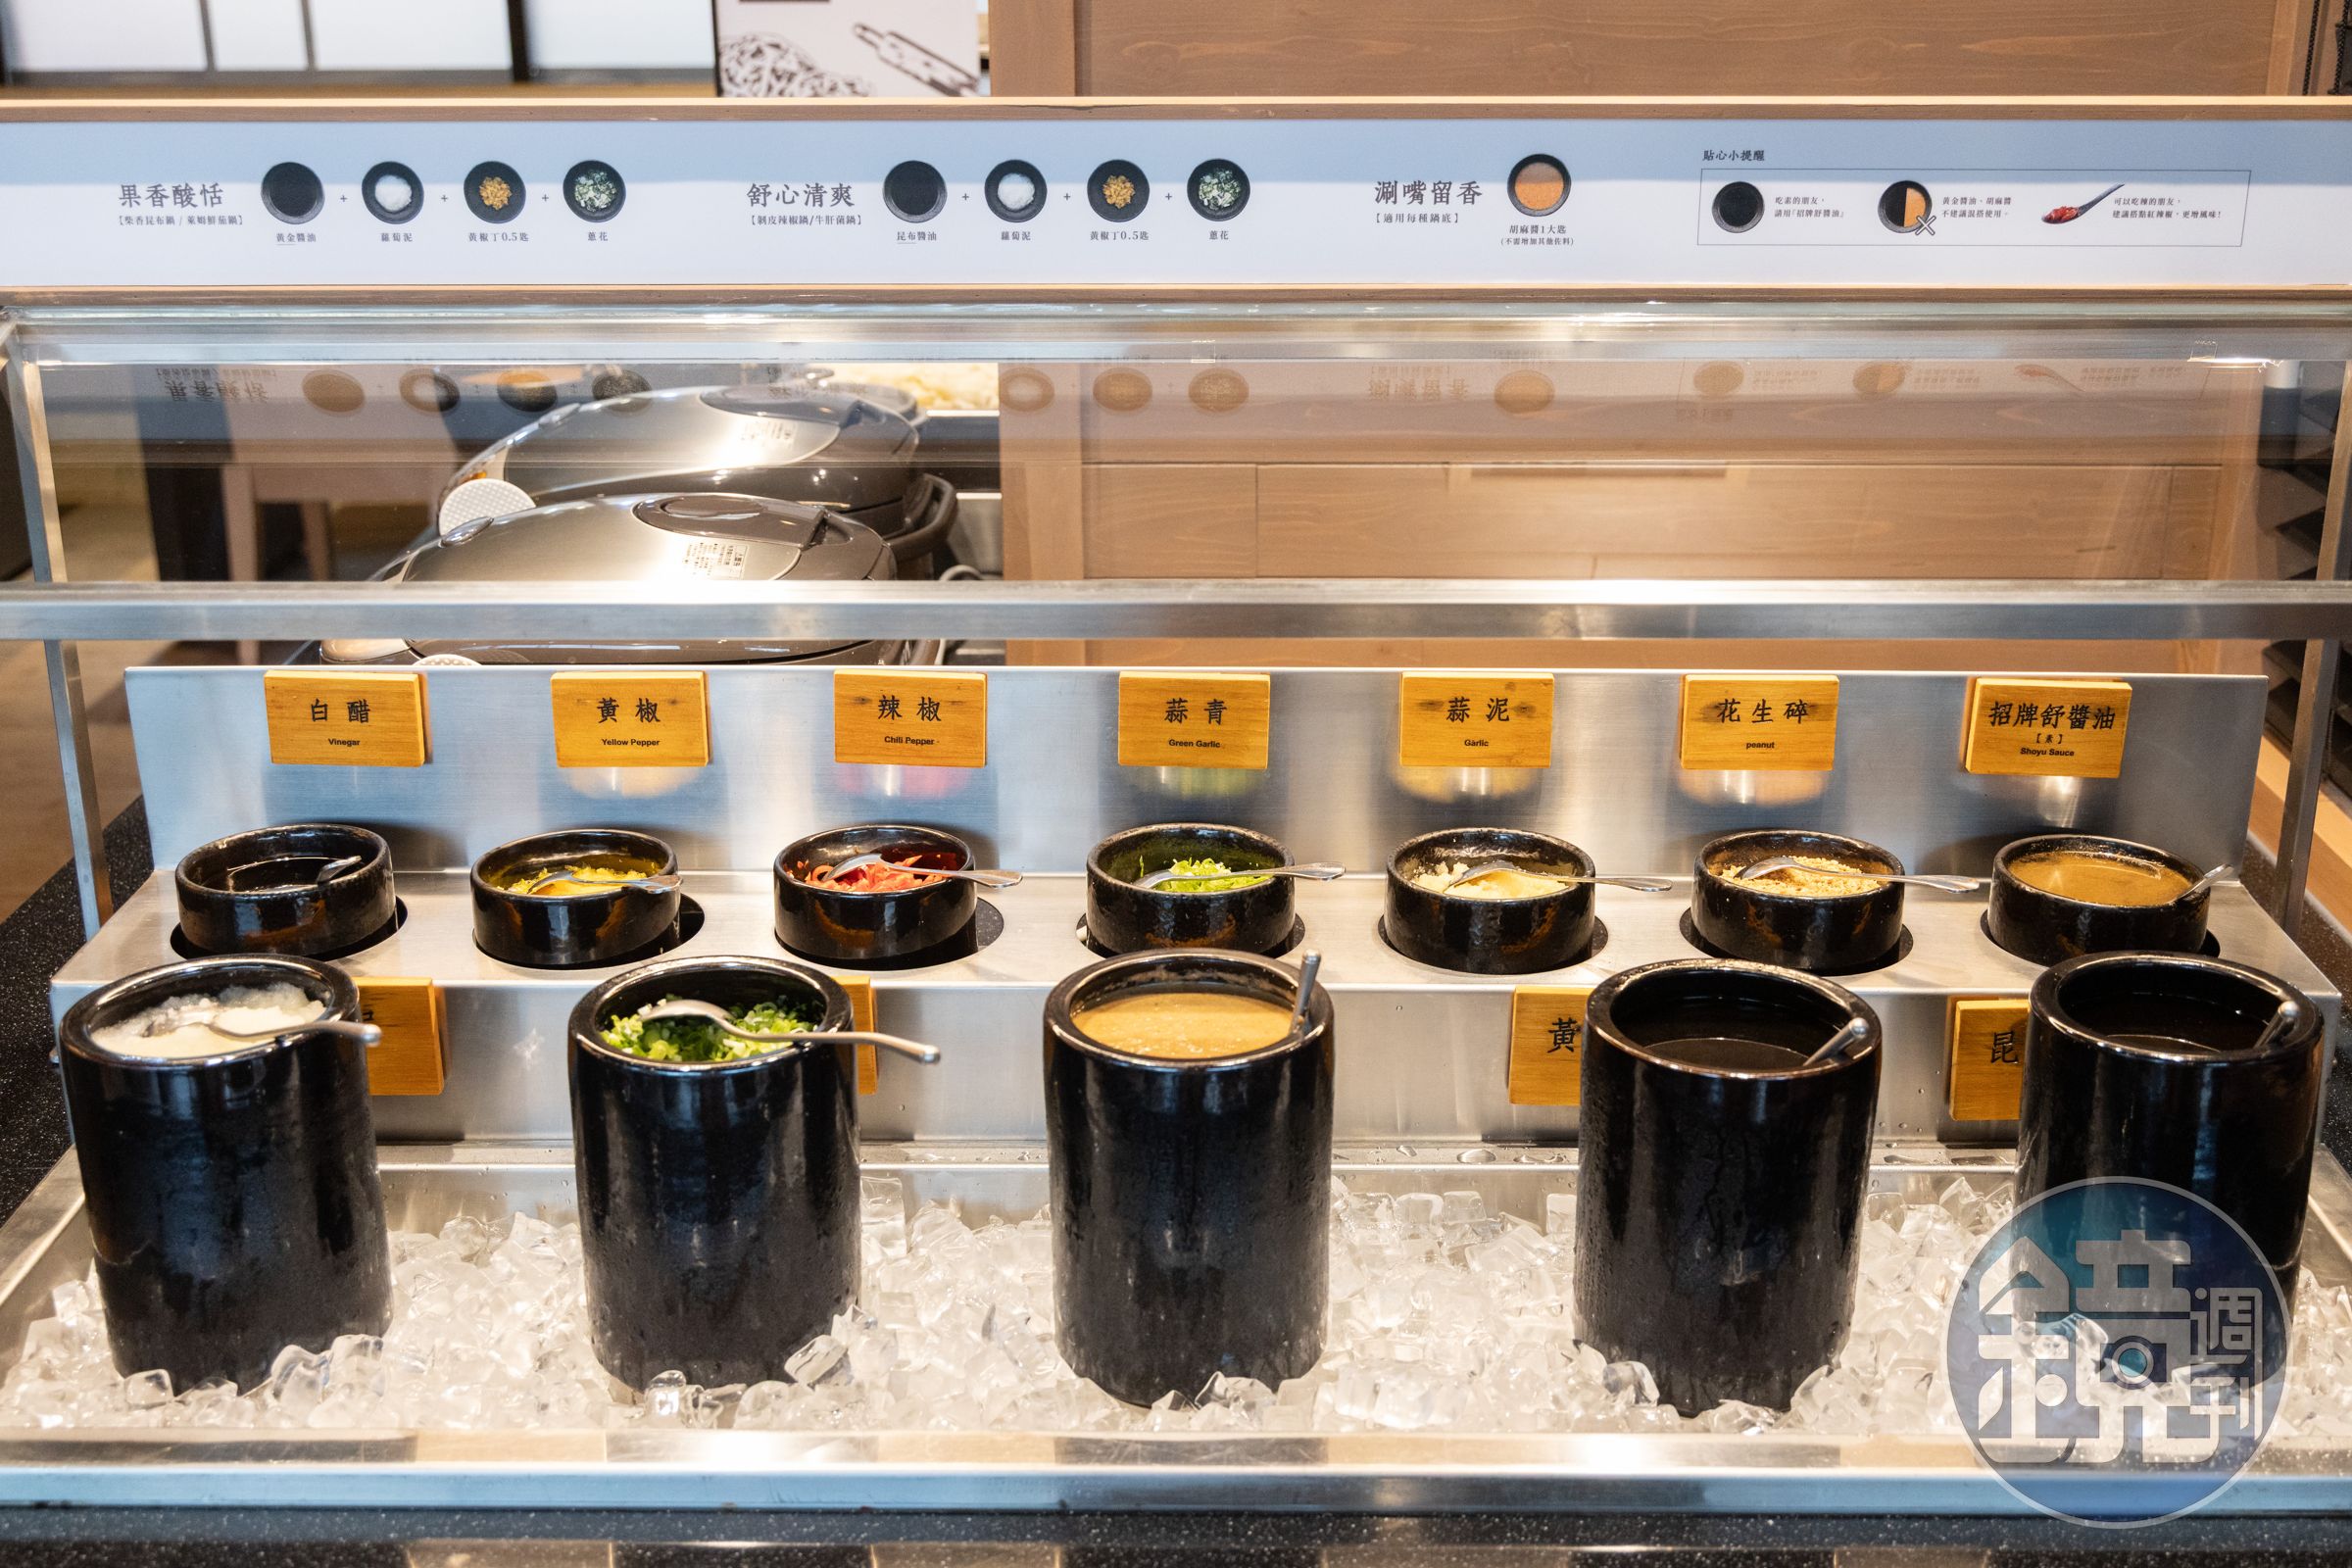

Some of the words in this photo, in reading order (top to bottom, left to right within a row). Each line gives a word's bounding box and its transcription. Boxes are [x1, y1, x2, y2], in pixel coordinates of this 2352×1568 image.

[1702, 149, 1765, 162] 貼心小提醒
[119, 182, 223, 208] 果香酸恬
[747, 182, 856, 208] 舒心清爽
[1374, 180, 1483, 205] 涮嘴留香
[1090, 230, 1150, 241] 黃椒丁0.5匙
[1208, 230, 1230, 240] 蔥花
[1509, 224, 1567, 234] 胡麻醬1大匙
[276, 232, 317, 243] 黃金醬油
[468, 231, 529, 243] 黃椒丁0.5匙
[587, 231, 609, 242] 蔥花
[897, 231, 937, 241] 昆布醬油
[310, 697, 371, 723] 白醋
[596, 697, 662, 724] 黃椒
[877, 694, 942, 722] 辣椒
[1164, 697, 1228, 726] 蒜青
[1446, 697, 1510, 723] 蒜泥
[1716, 698, 1809, 724] 花生碎
[1987, 701, 2116, 730] 招牌舒醬油
[328, 738, 361, 748] Vinegar
[601, 738, 628, 747] Yellow
[630, 738, 661, 749] Pepper
[884, 735, 904, 745] Chili
[905, 737, 935, 748] Pepper
[1168, 739, 1195, 748] Green
[1196, 739, 1221, 749] Garlic
[1464, 738, 1489, 748] Garlic
[1745, 740, 1775, 750] peanut
[2020, 747, 2047, 757] Shoyu
[2048, 749, 2075, 758] Sauce
[1546, 1016, 1581, 1054] 黃
[1990, 1030, 2019, 1064] 昆
